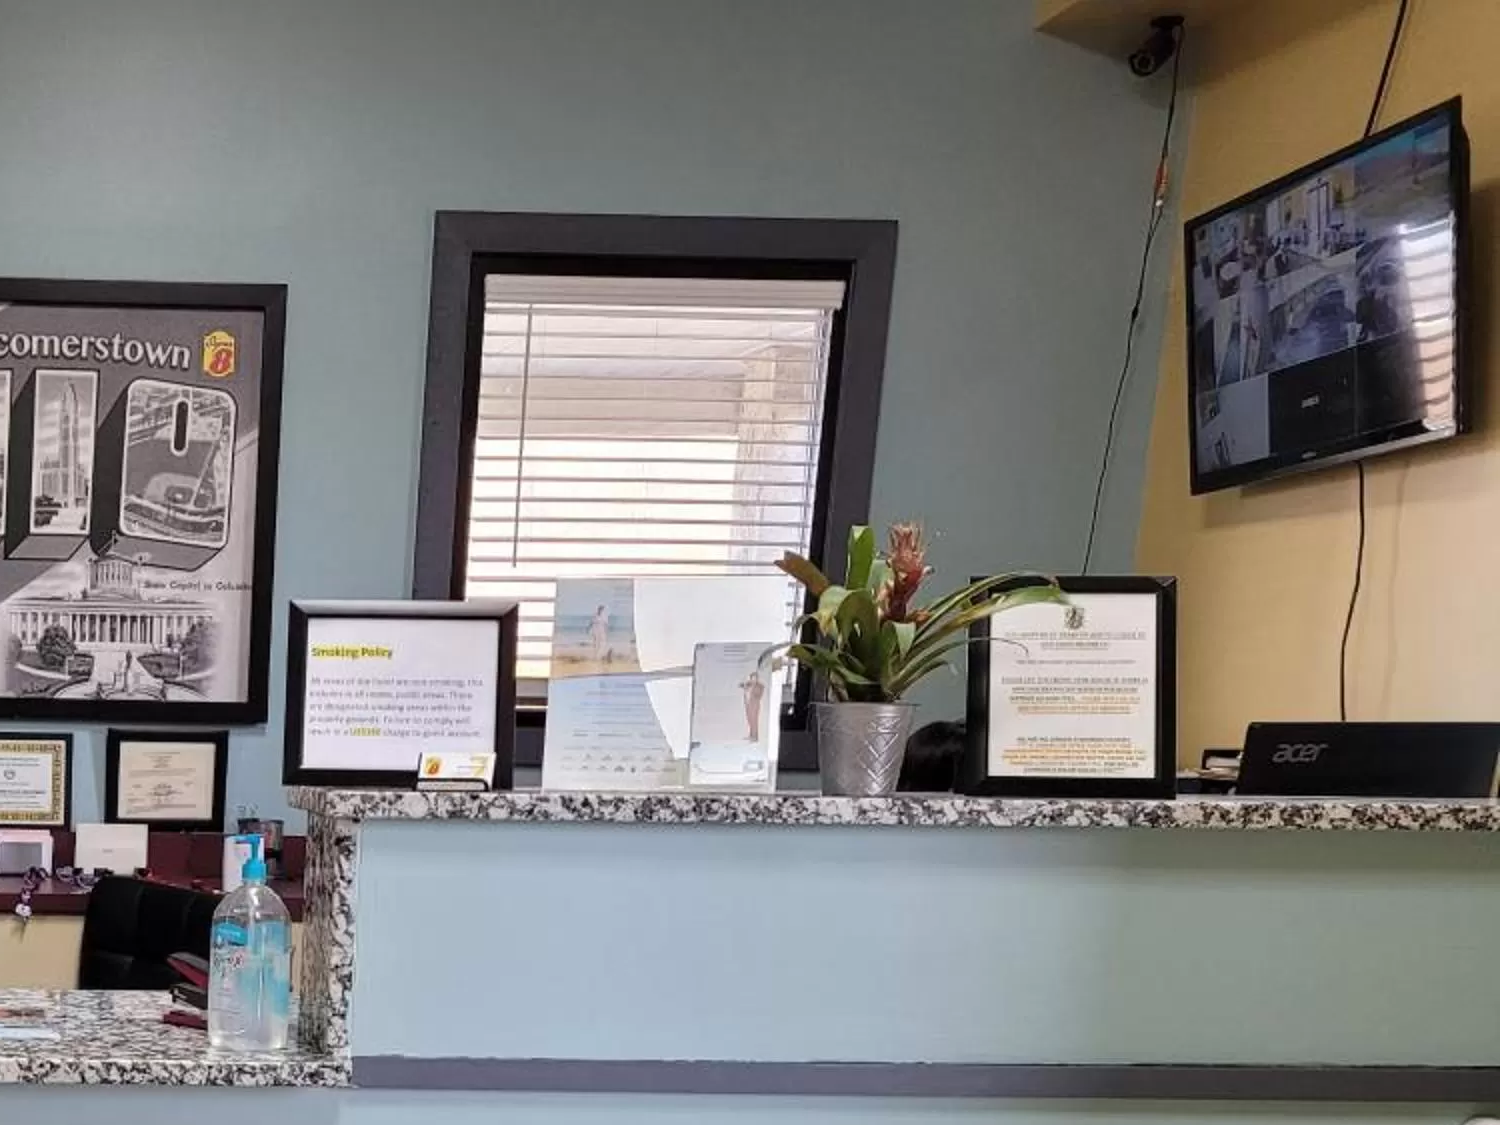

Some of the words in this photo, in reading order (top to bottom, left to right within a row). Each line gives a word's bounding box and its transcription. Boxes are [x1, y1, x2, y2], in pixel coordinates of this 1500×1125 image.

[311, 648, 358, 660] Smoking
[361, 647, 392, 660] Policy
[1272, 743, 1329, 762] acer
